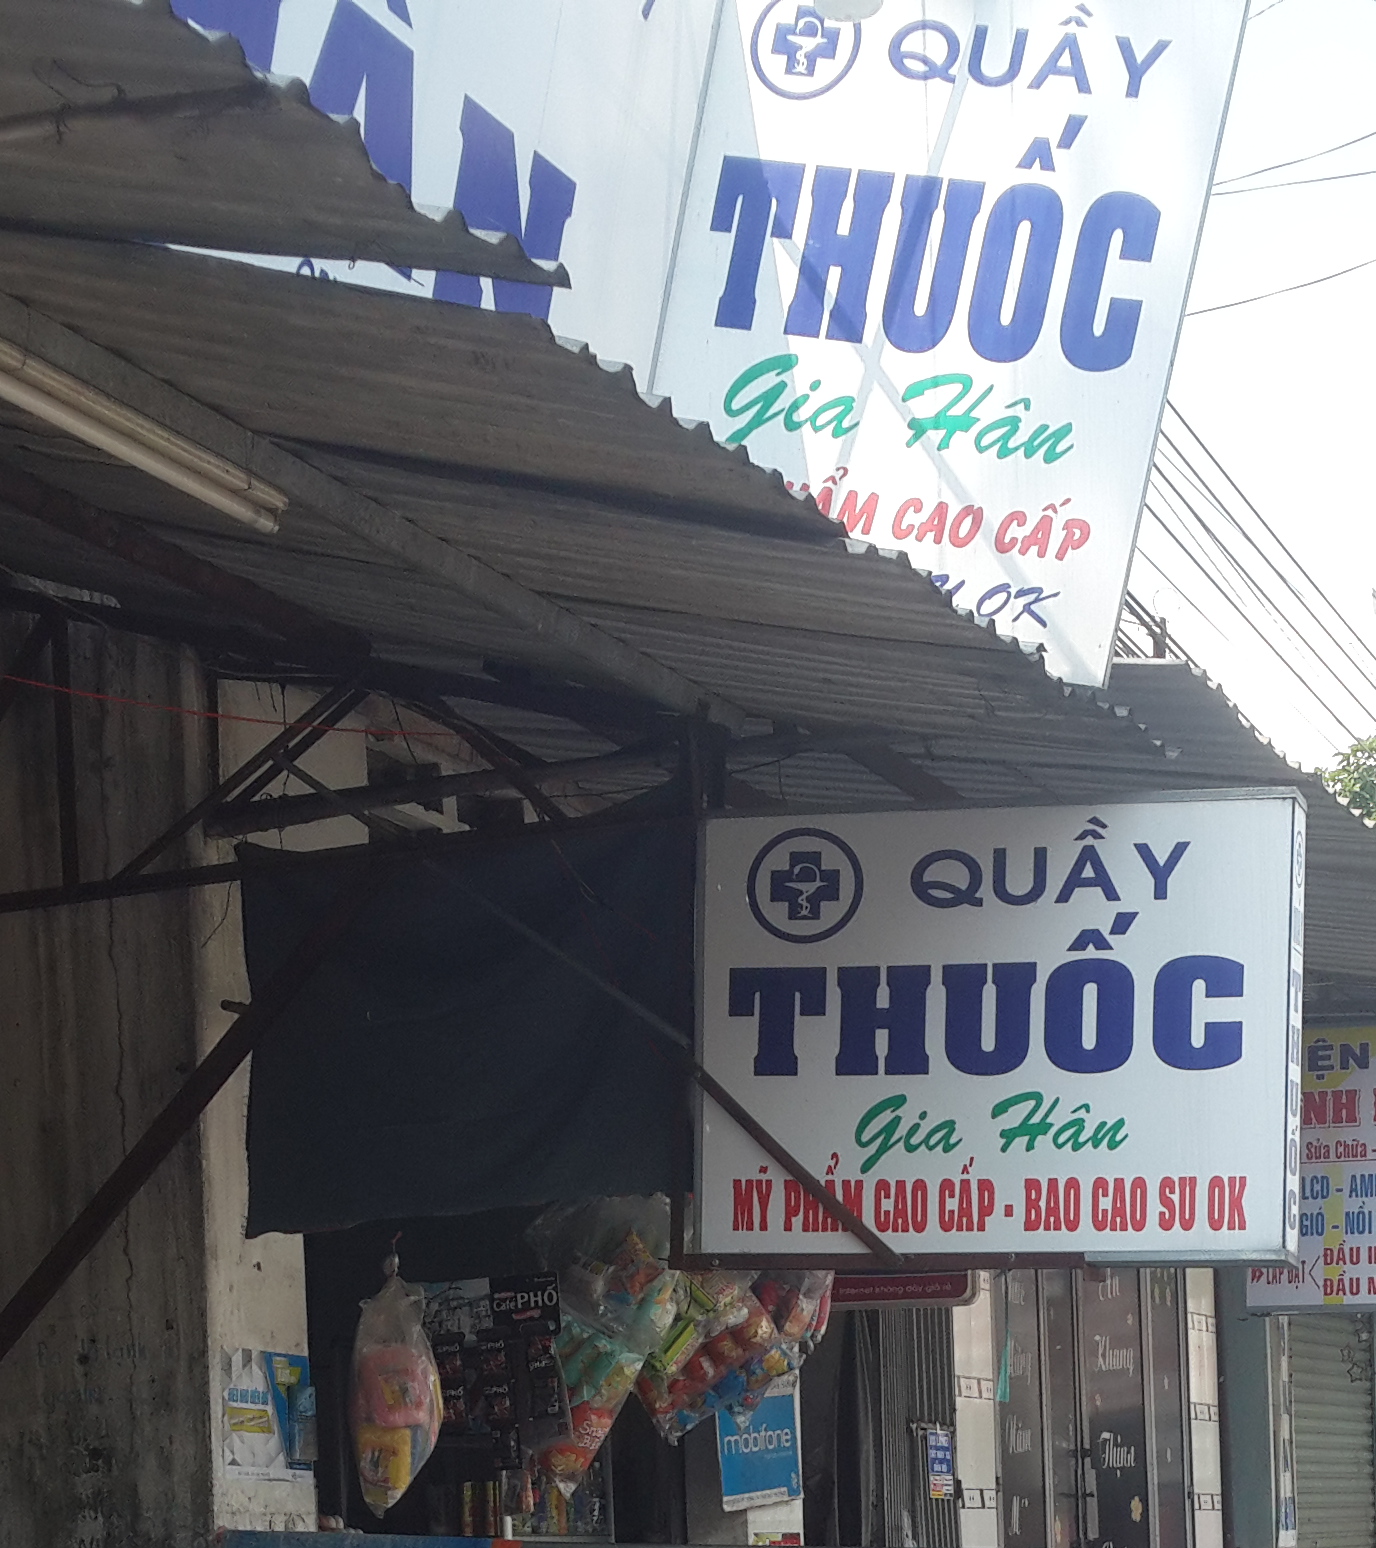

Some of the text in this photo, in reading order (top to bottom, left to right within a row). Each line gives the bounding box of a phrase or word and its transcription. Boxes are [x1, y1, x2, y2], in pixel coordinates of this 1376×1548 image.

[888, 3, 1173, 99] QUẦY
[709, 114, 1162, 373] THUỐC
[723, 354, 1074, 465] Gia Hân
[892, 498, 1092, 562] CAO CẤP
[975, 582, 1061, 629] OK
[910, 815, 1192, 909] QUẦY
[727, 911, 1245, 1078] THUỐC
[853, 1090, 1130, 1175] Gia Hân
[1305, 1136, 1331, 1161] Sửa
[1335, 1138, 1368, 1160] Chữa
[732, 1152, 1248, 1234] MỸ PHẨM CAO CẤP BAO CAO SU OK
[1301, 1175, 1330, 1201] LCD
[1323, 1239, 1362, 1267] ĐẦU
[516, 1283, 558, 1311] PHỐ
[724, 1423, 792, 1457] mobifone
